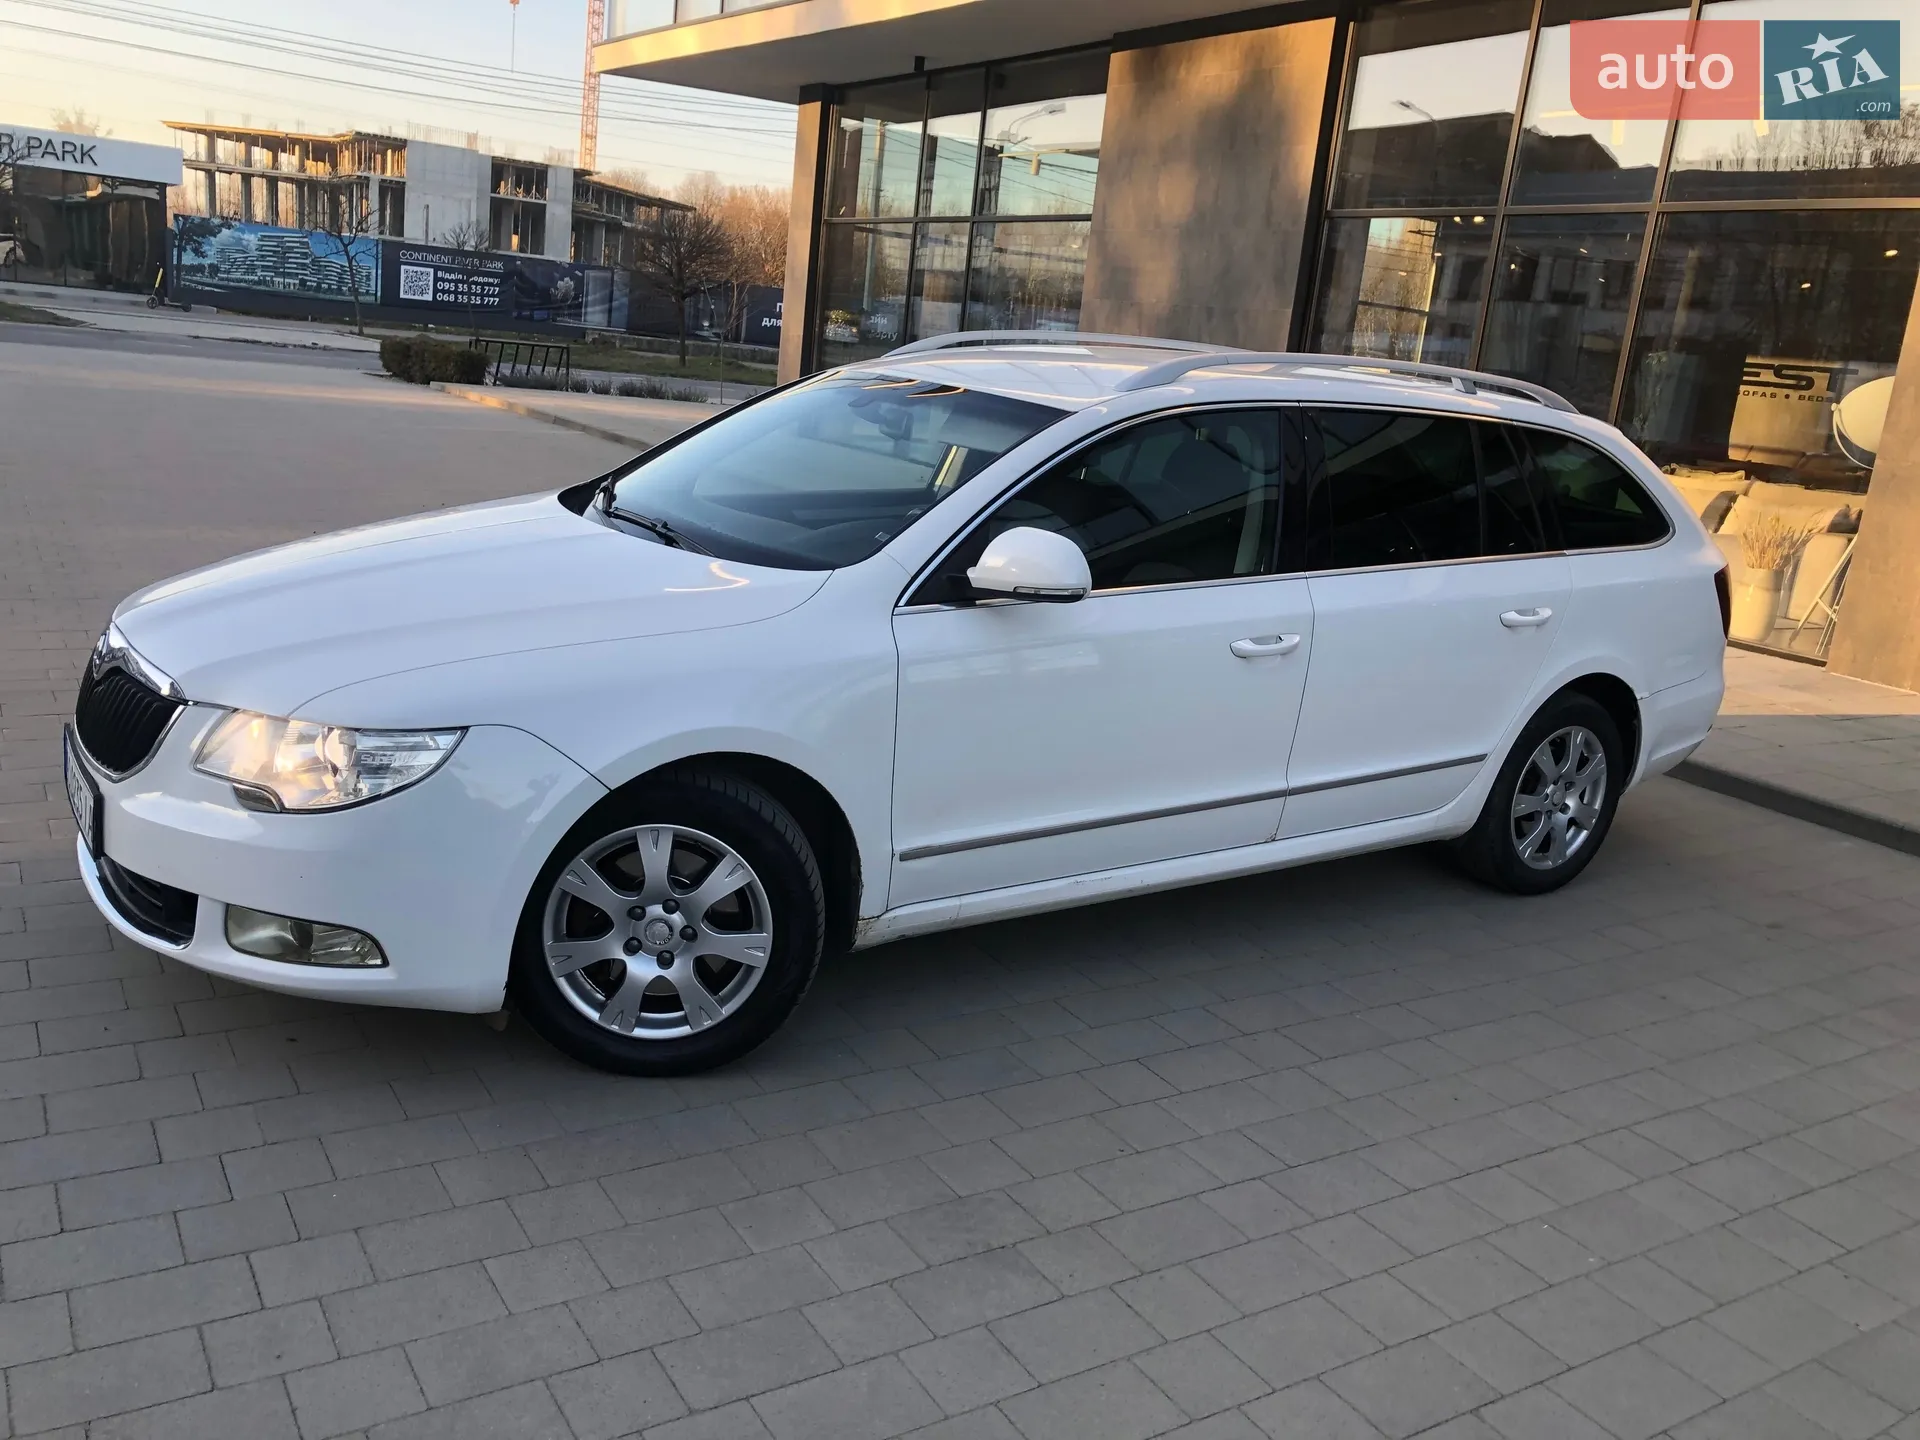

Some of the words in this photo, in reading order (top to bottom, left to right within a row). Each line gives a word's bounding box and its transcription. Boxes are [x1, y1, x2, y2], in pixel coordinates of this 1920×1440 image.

[27, 136, 98, 166] PARK
[400, 250, 452, 264] CONTINENT
[481, 259, 504, 269] PARK
[437, 281, 455, 291] 095
[457, 283, 468, 292] 35
[471, 284, 481, 293] 35
[484, 286, 499, 295] 777
[436, 292, 455, 302] 068
[457, 294, 468, 303] 35
[470, 295, 481, 304] 35
[483, 297, 499, 306] 777
[1737, 390, 1777, 399] OFAS
